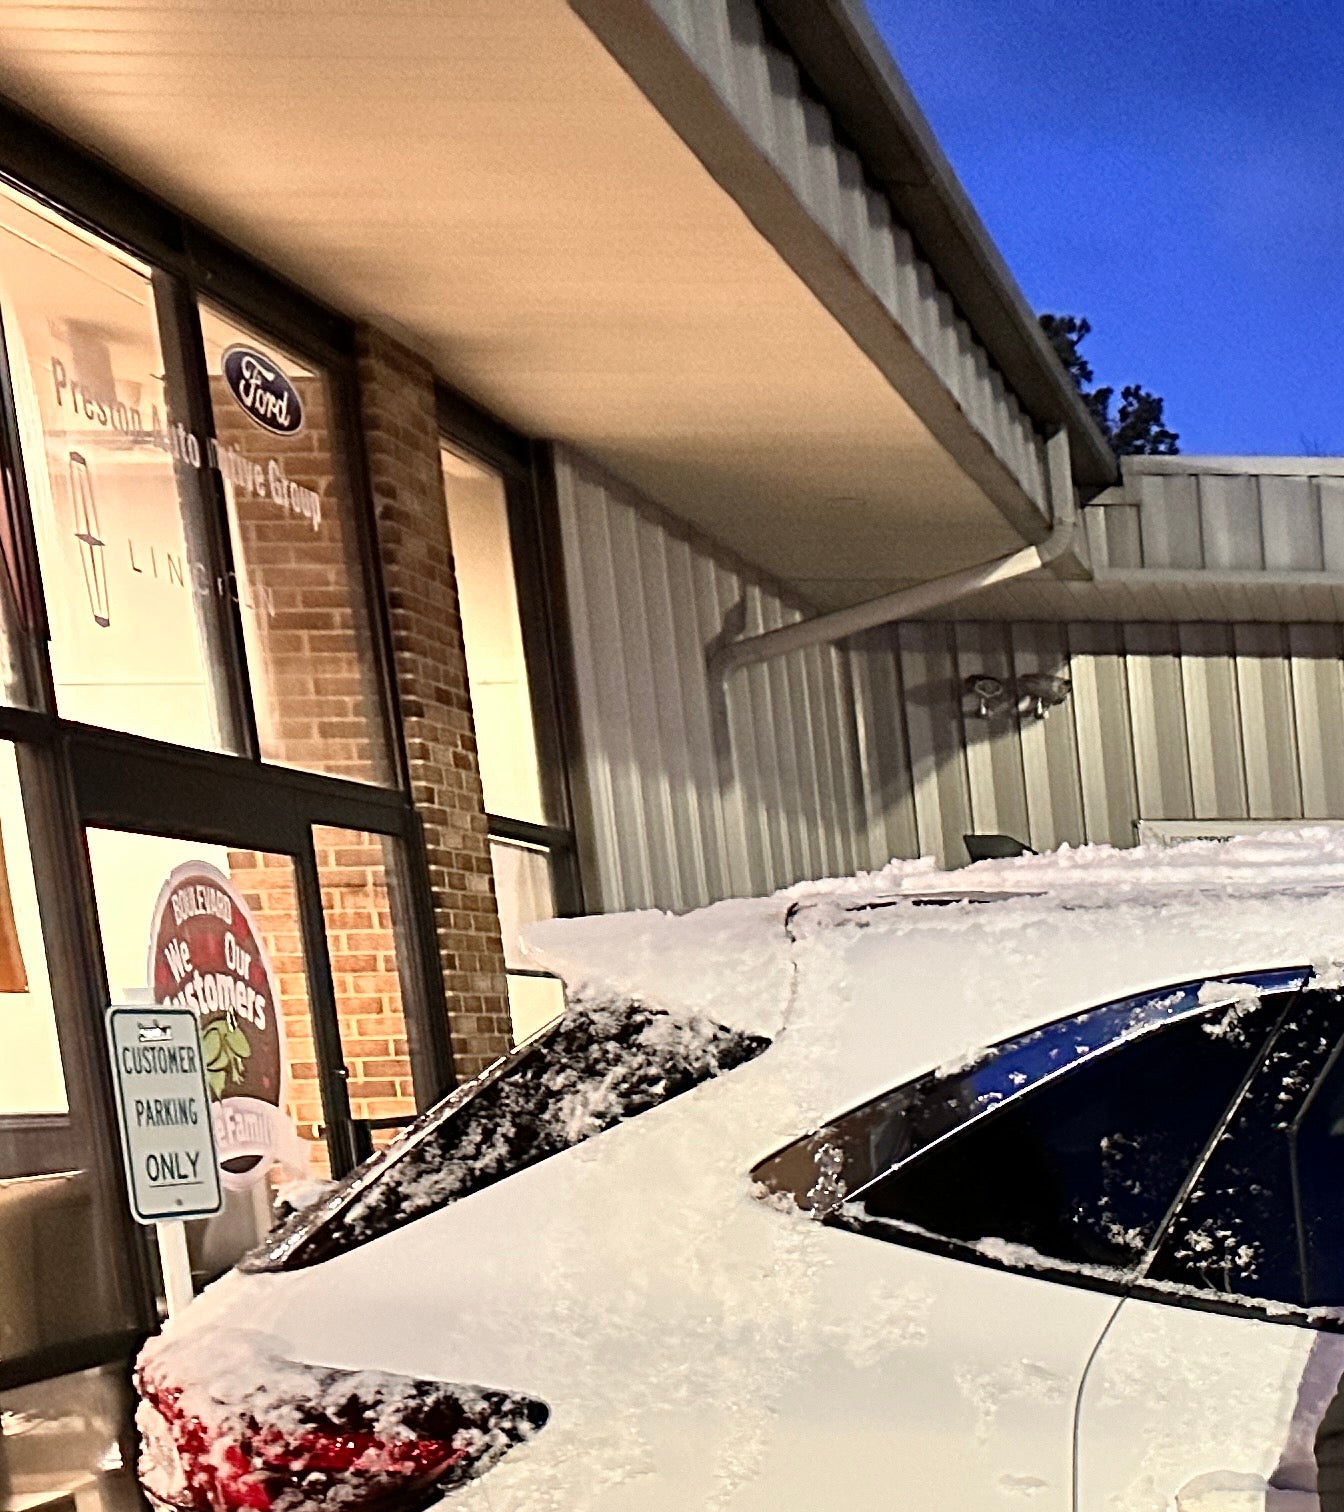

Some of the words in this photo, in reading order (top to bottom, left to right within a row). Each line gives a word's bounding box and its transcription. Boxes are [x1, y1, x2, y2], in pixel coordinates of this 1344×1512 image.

[237, 353, 293, 430] Ford
[51, 356, 144, 437] Preston
[269, 459, 322, 532] Group
[164, 938, 193, 983] We
[224, 931, 252, 980] Our
[163, 969, 266, 1030] stomers
[122, 1046, 197, 1075] CUSTOMER
[135, 1098, 198, 1128] PARKING
[146, 1152, 200, 1182] ONLY
